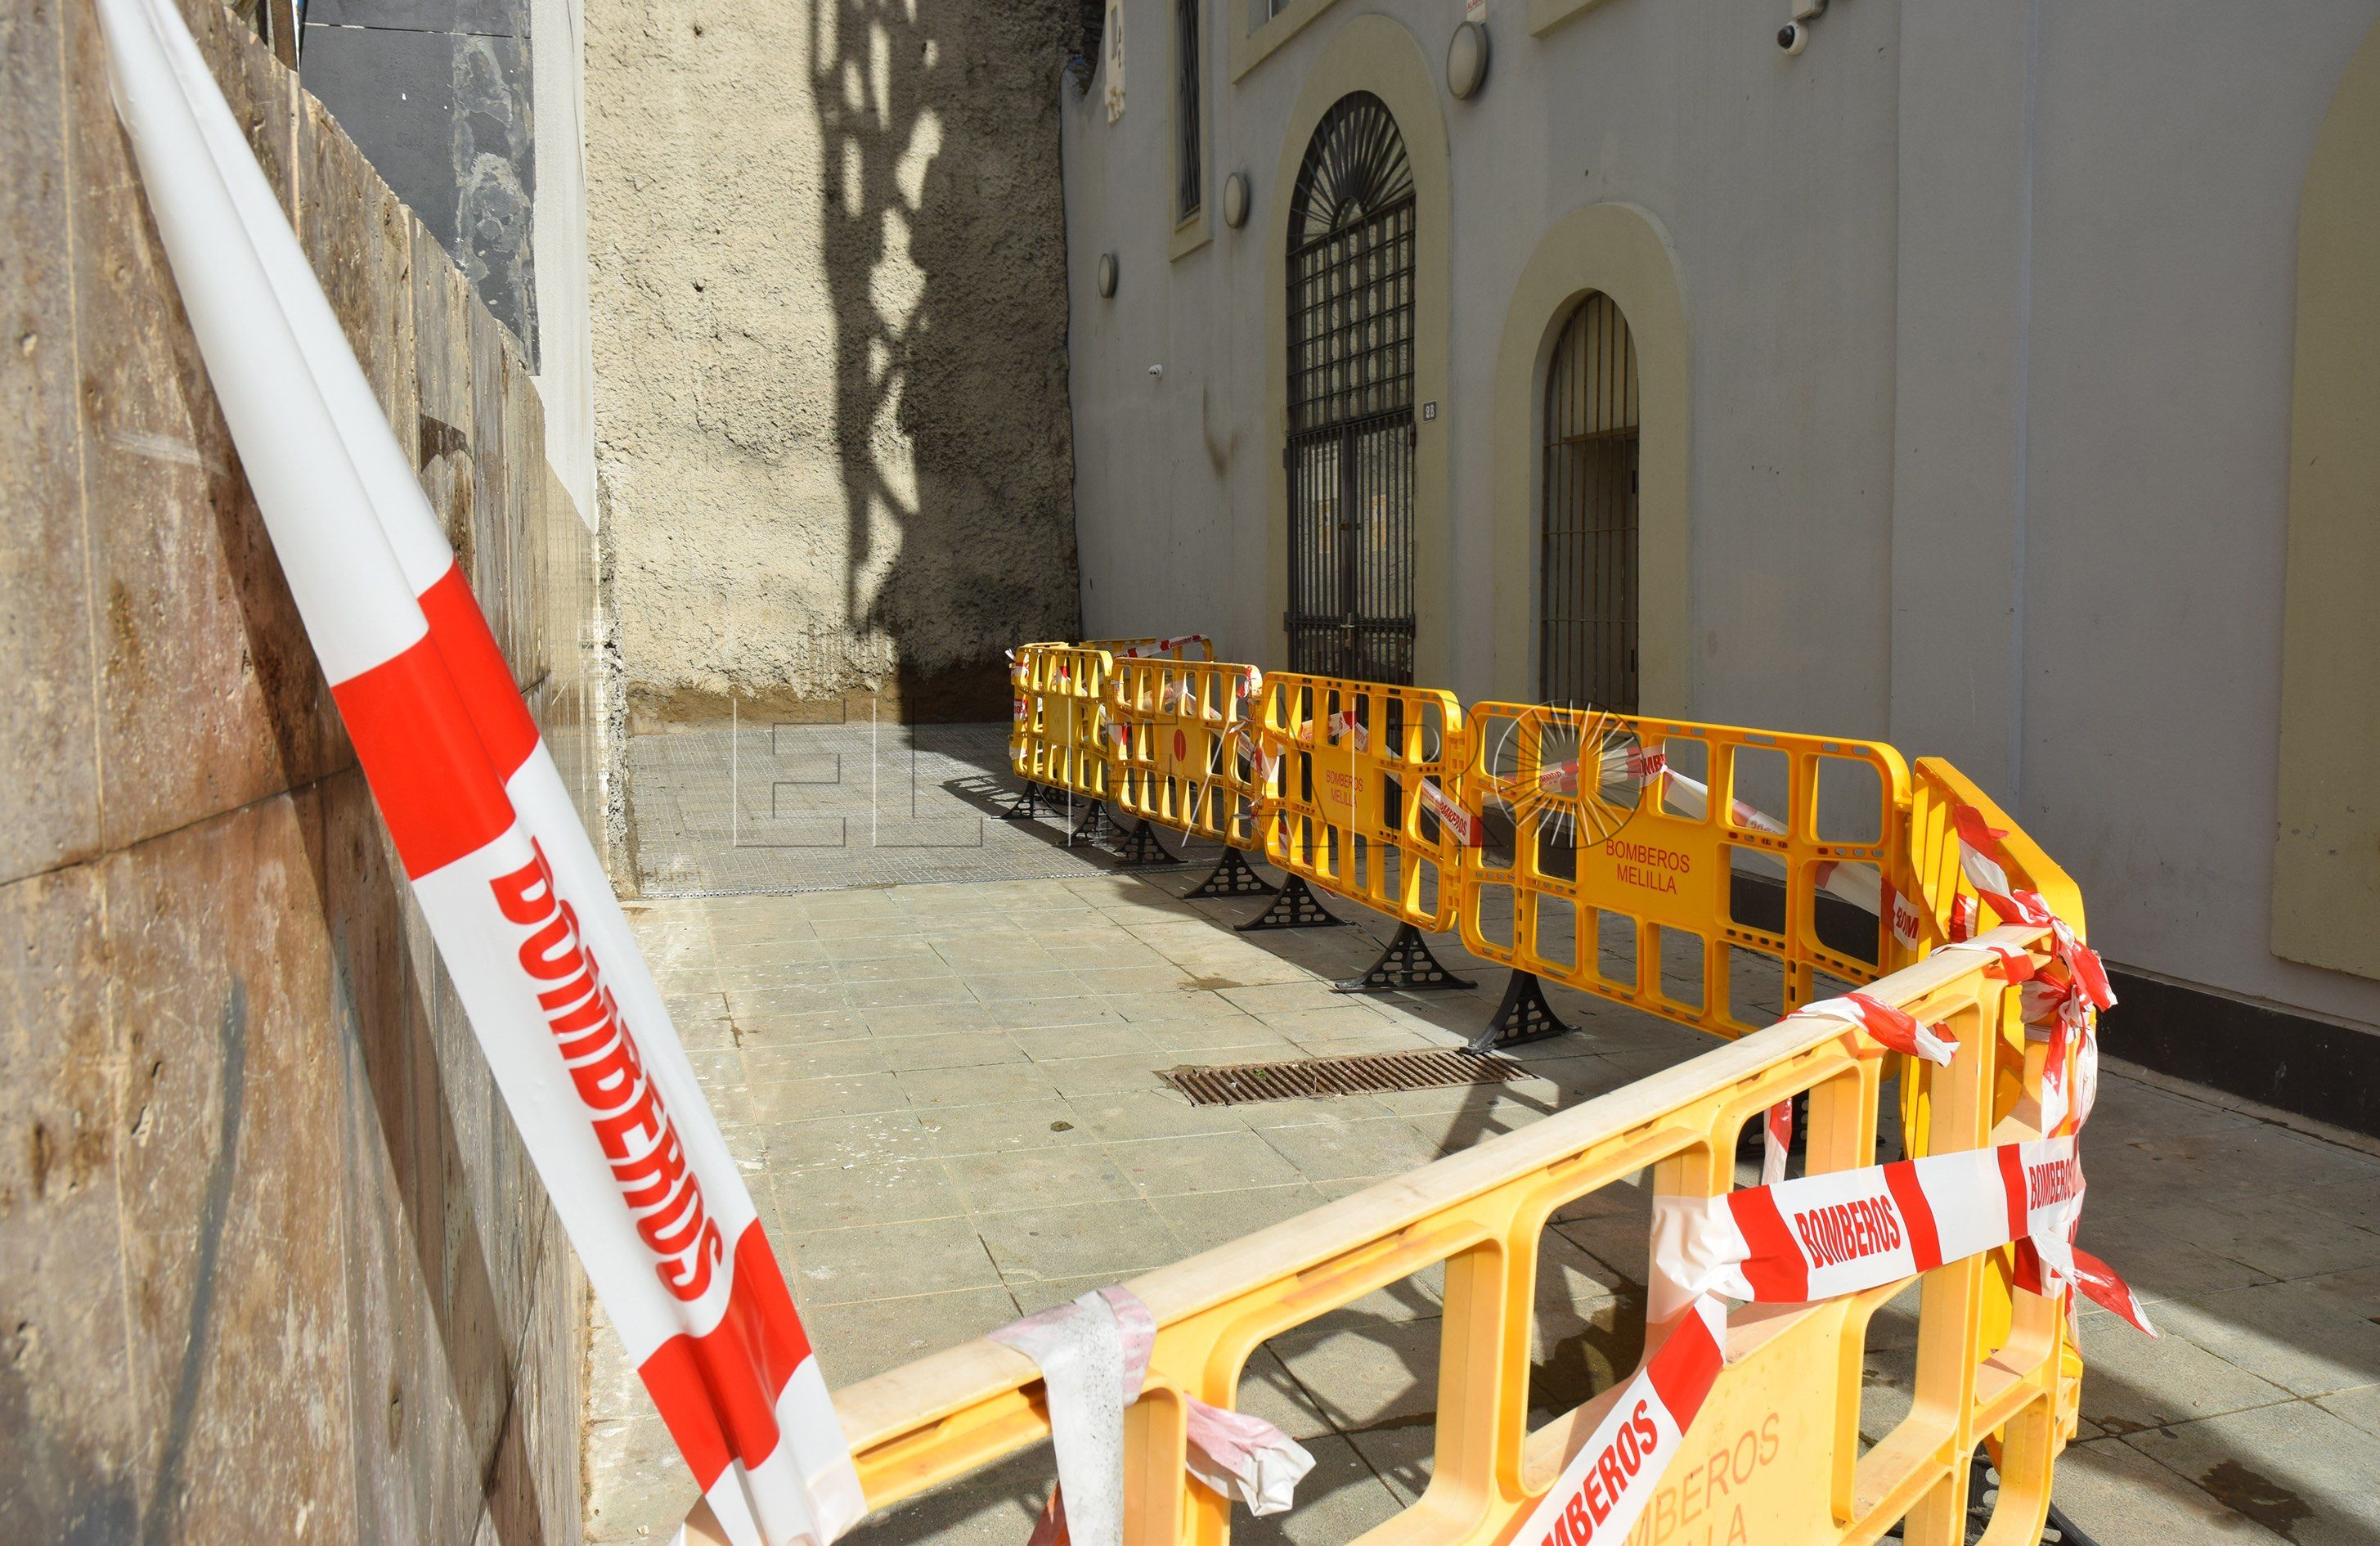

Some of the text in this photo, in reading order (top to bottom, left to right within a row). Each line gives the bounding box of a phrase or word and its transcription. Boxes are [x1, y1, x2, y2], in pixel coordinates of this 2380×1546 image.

[1327, 771, 1363, 791] BOMBEROS
[1332, 789, 1358, 807] MELILLA
[1606, 839, 1690, 874] BOMBEROS
[1617, 864, 1677, 895] MELILLA
[488, 835, 724, 1303] BOMBEROS
[1794, 1195, 1902, 1270] BOMBEROS
